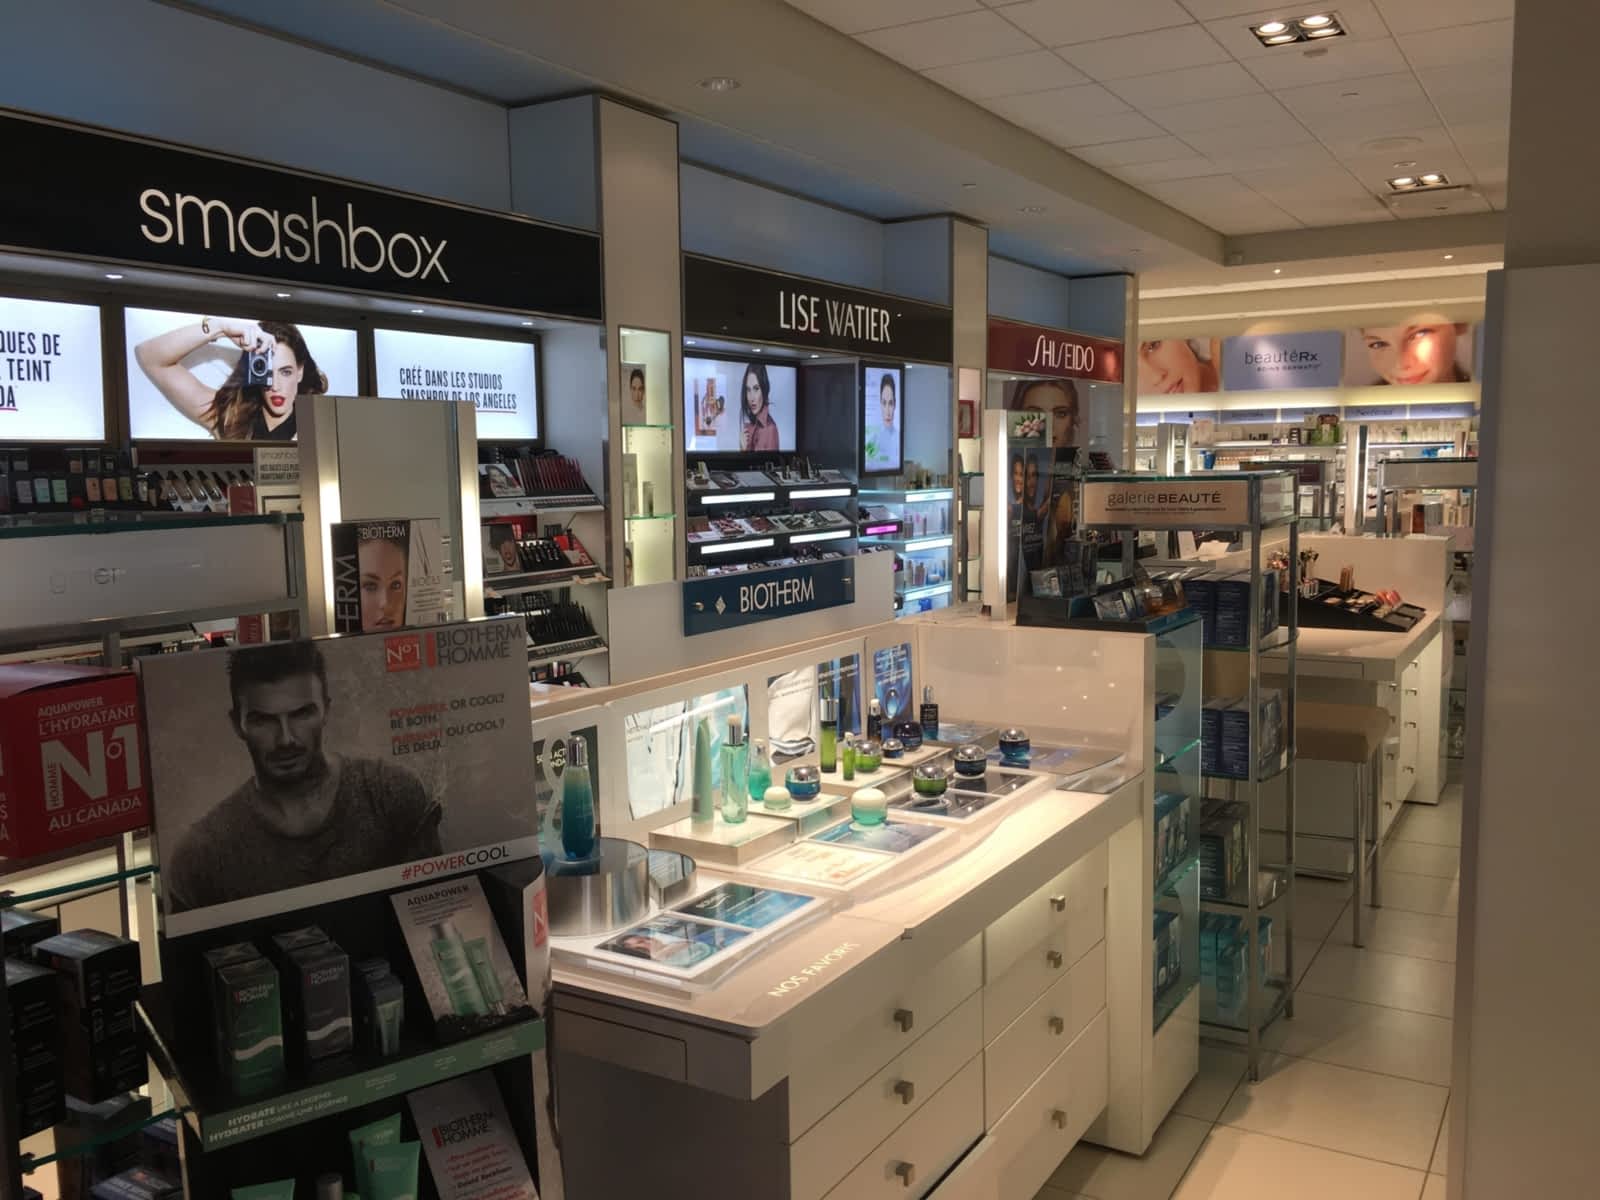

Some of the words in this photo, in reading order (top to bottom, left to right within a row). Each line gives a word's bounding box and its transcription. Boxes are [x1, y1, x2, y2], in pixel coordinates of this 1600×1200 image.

[139, 187, 450, 284] smashbox
[779, 290, 820, 333] LISE
[825, 299, 891, 344] WATIER
[42, 333, 61, 356] DE
[1027, 335, 1095, 372] SHISEIDO
[6, 358, 51, 382] TEINT
[425, 369, 449, 388] DANS
[450, 371, 467, 389] LES
[468, 372, 503, 391] STUDIOS
[482, 393, 518, 409] ANGELES
[362, 525, 406, 540] BIOTHERM
[739, 576, 815, 613] BIOTHERM
[436, 623, 522, 649] BIOTHERM
[437, 641, 512, 667] HOMME
[37, 696, 104, 718] AQUAPOWER
[450, 699, 467, 711] OR
[39, 704, 136, 736] L'HYDRATANT
[446, 725, 465, 737] OU
[392, 743, 410, 756] LES
[47, 759, 60, 807] HOMME
[48, 814, 72, 832] AU
[76, 796, 142, 824] CANADA
[401, 845, 510, 881] #POWERCOOL
[407, 884, 470, 907] AQUAPOWER
[768, 975, 809, 997] NOS
[228, 1106, 276, 1127] HYDRATE
[208, 1119, 264, 1143] HYDRATER
